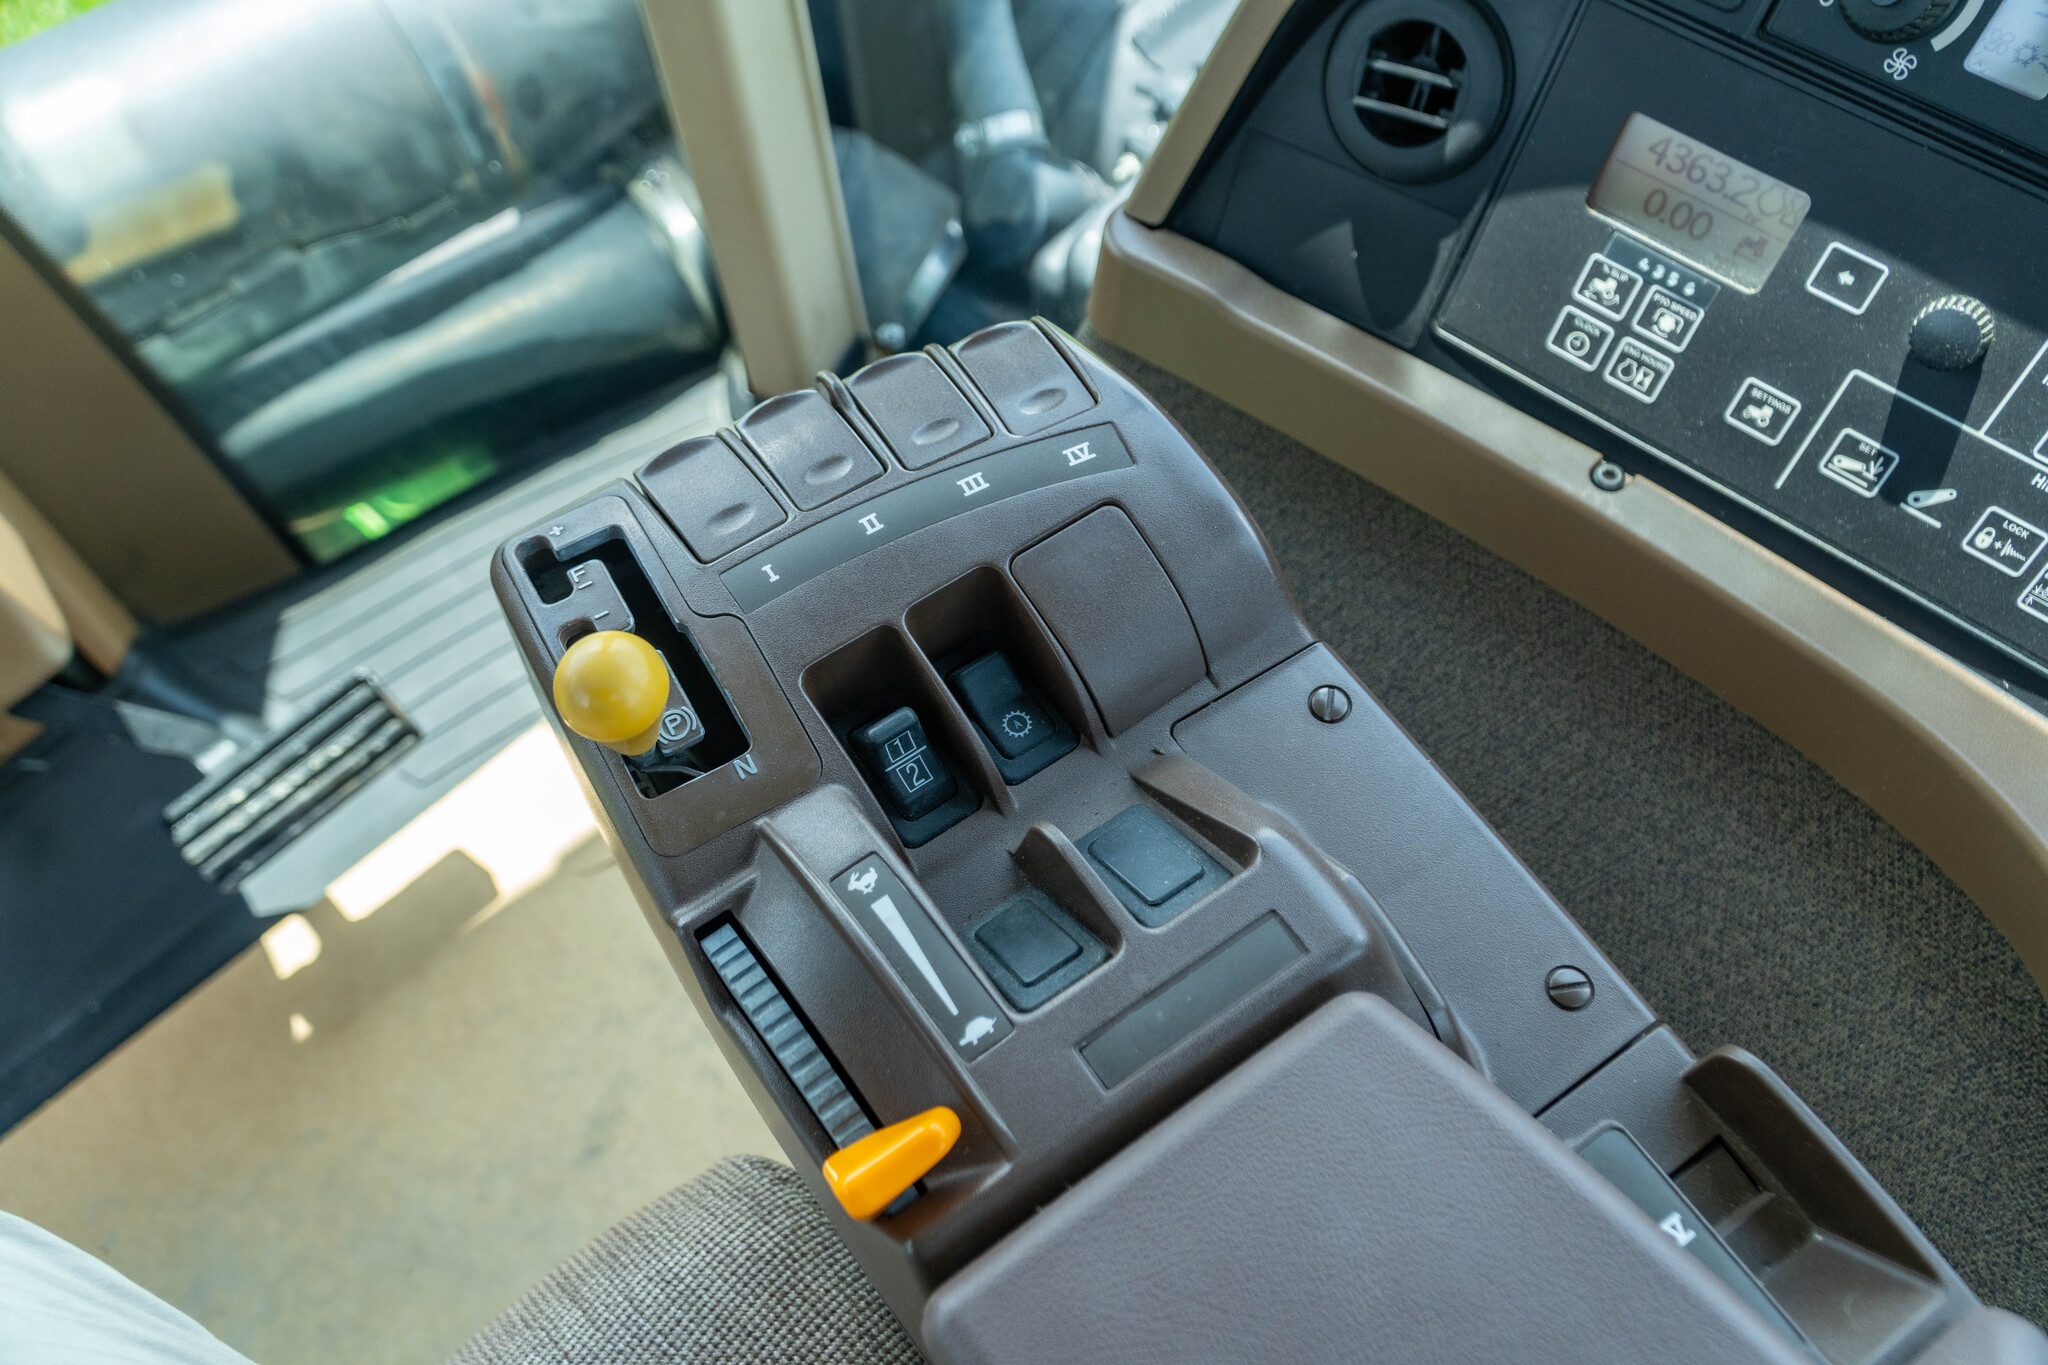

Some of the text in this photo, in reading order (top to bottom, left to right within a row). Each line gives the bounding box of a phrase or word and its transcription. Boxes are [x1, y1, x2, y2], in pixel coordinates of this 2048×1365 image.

[1648, 136, 1760, 209] 4363.2
[1643, 188, 1714, 240] 0.00
[1610, 266, 1630, 283] SLIP
[1653, 291, 1698, 322] PTO SPEED
[1574, 316, 1602, 338] CLOCK
[1640, 352, 1669, 375] HOURS
[1751, 386, 1793, 416] SETTINGS
[1062, 441, 1098, 467] IV
[1858, 441, 1879, 457] SET
[956, 471, 990, 497] III
[858, 512, 885, 536] II
[2002, 518, 2031, 541] LOCK
[569, 564, 586, 584] F
[761, 563, 781, 583] I
[663, 719, 683, 737] P
[892, 737, 906, 756] 1
[732, 753, 759, 781] N
[905, 761, 926, 787] 2
